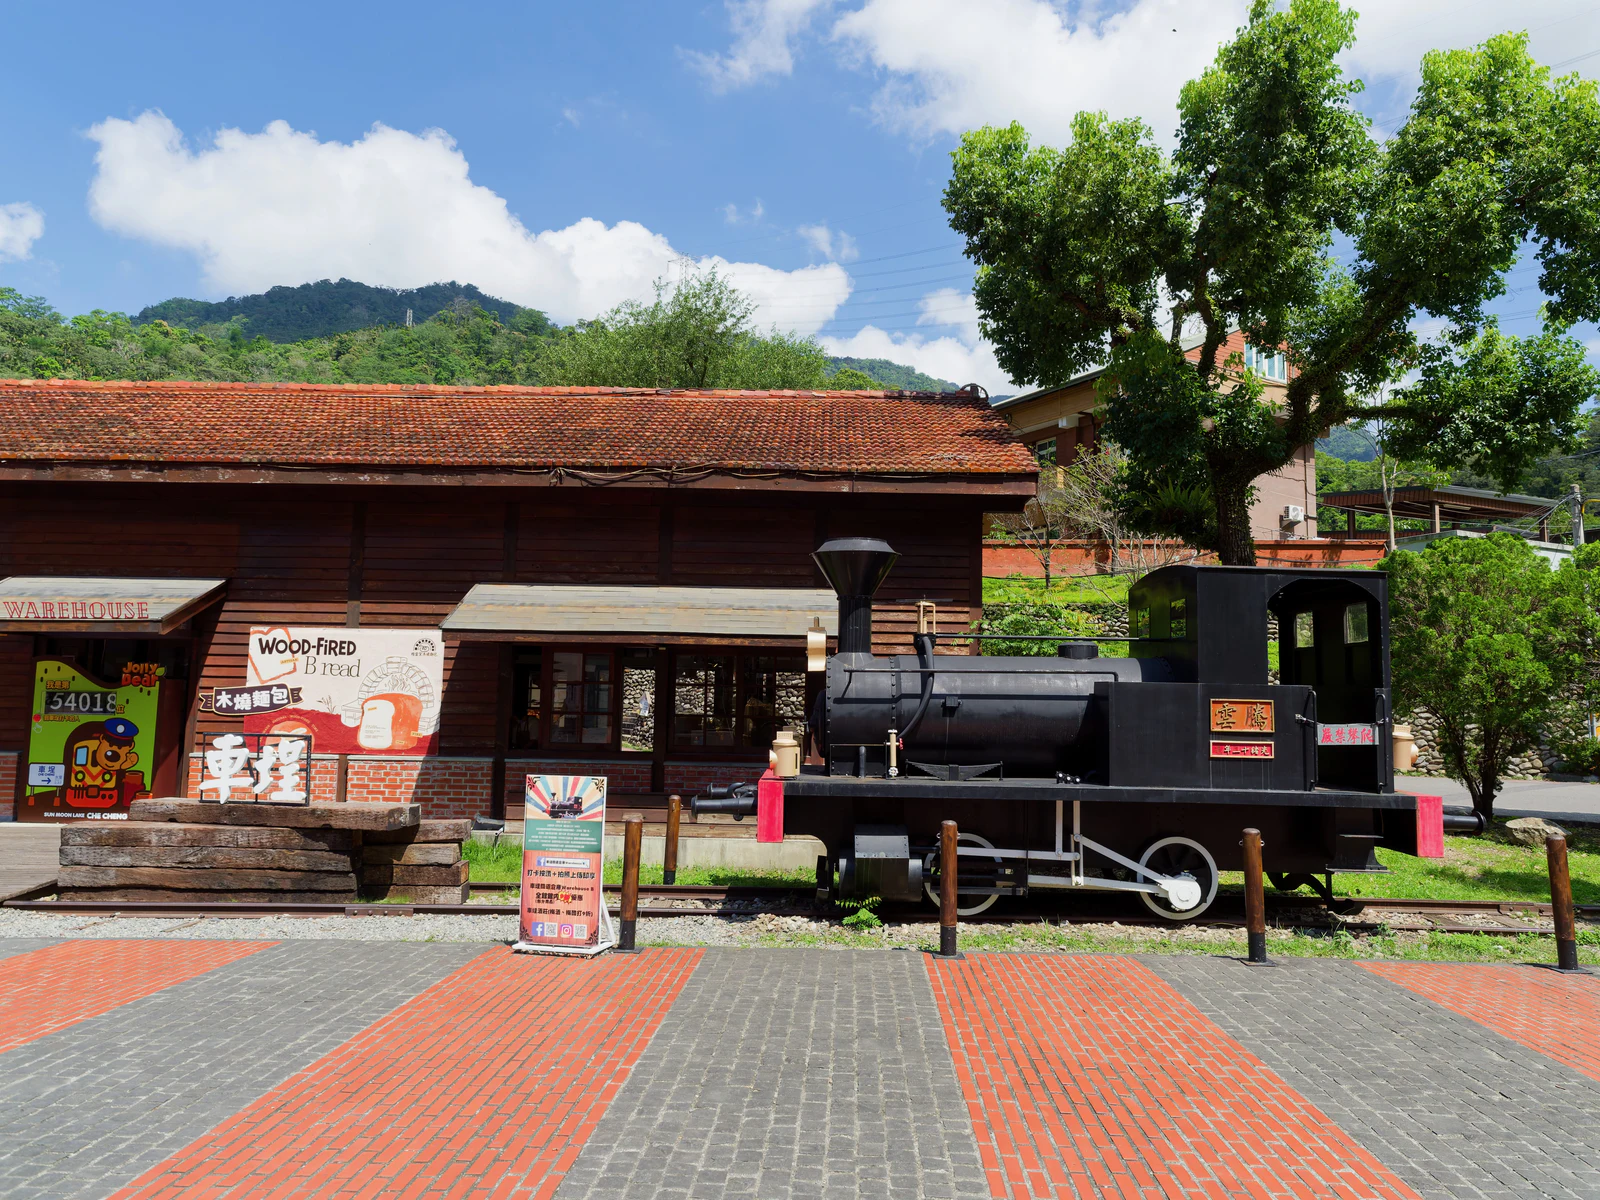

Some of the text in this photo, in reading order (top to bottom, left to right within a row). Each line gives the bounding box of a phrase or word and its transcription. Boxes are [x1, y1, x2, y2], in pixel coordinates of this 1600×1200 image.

[3, 601, 149, 619] WAREHOUSE
[122, 661, 158, 674] Jolly
[50, 692, 117, 712] 54018
[215, 686, 288, 711] 木燒麵包
[1321, 727, 1375, 744] 嚴禁攀爬
[199, 734, 307, 804] 車埕
[86, 812, 101, 820] CHE
[102, 812, 128, 820] CHENG
